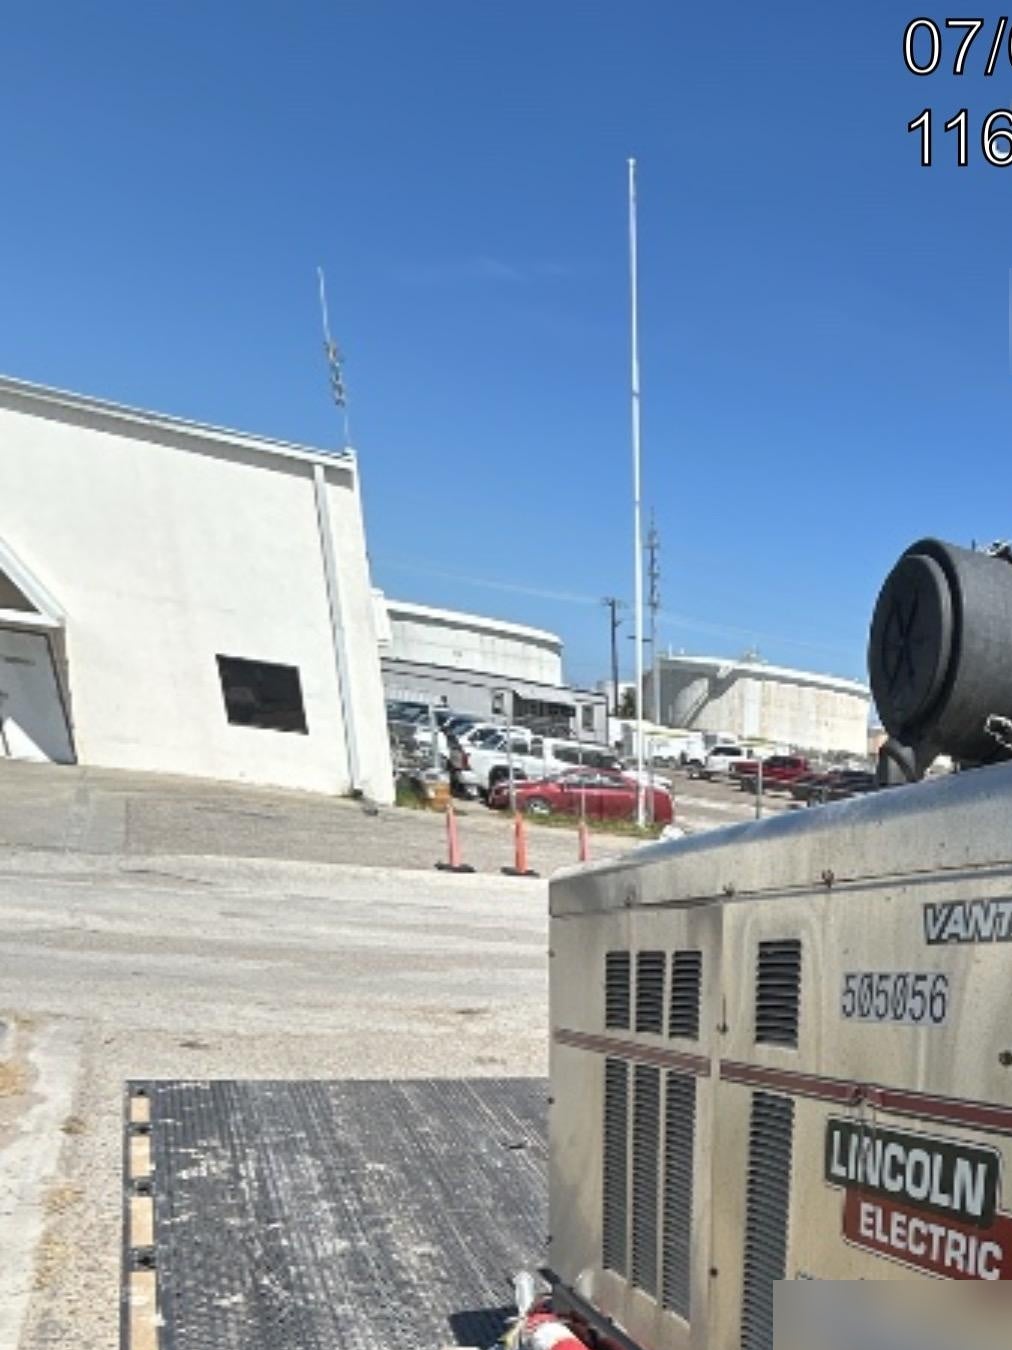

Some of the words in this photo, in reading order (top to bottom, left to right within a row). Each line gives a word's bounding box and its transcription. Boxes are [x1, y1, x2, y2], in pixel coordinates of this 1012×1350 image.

[841, 972, 949, 1024] 505056
[831, 1129, 988, 1217] LINCOLN
[858, 1200, 1003, 1280] ELECTRIC
